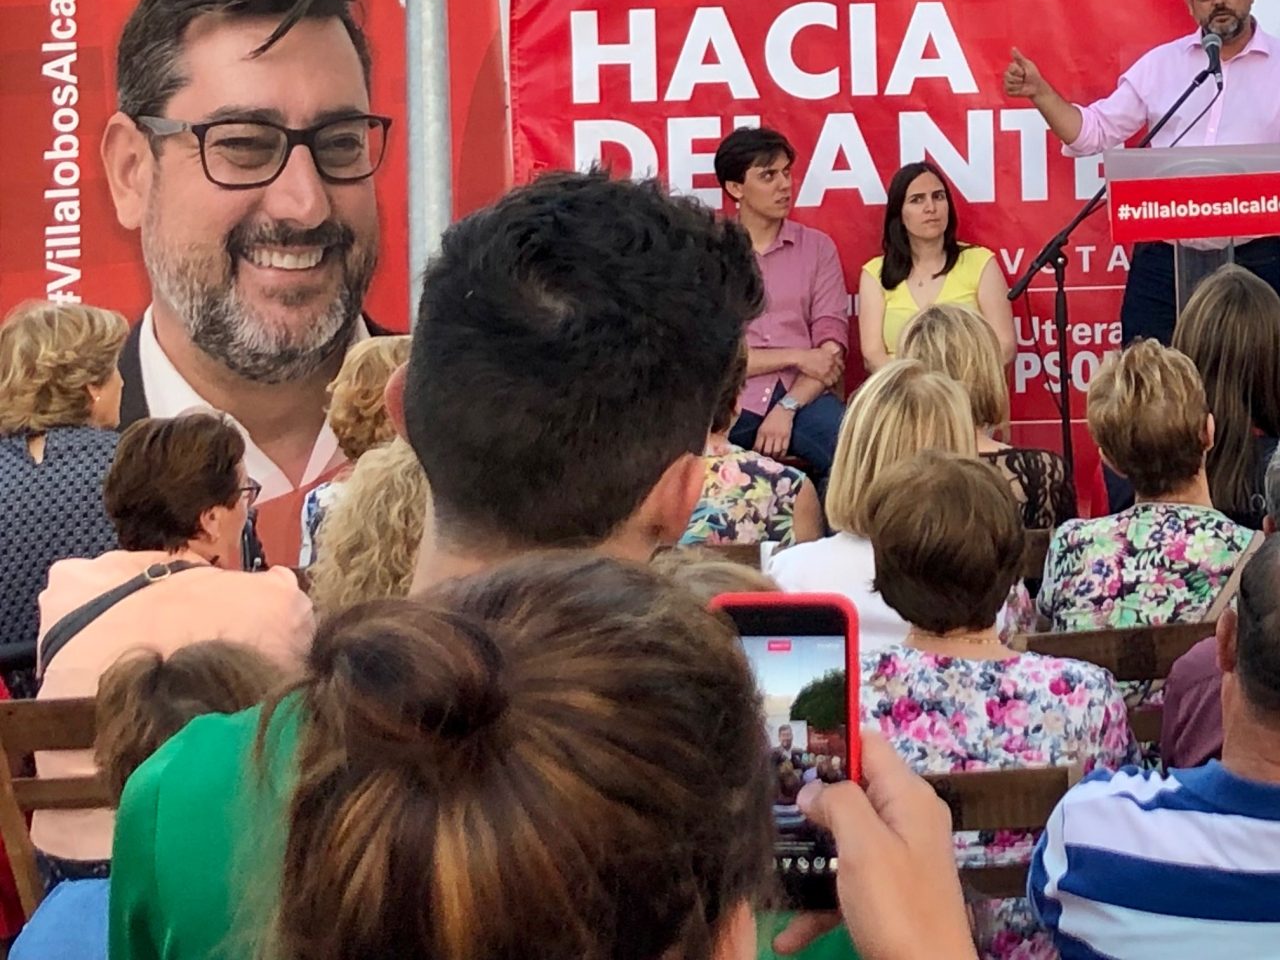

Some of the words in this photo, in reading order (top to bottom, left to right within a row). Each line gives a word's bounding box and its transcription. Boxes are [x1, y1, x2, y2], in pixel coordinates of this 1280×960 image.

[570, 1, 980, 104] HACIA
[573, 108, 1108, 212] DEANT
[1000, 244, 1131, 275] VTA
[1014, 316, 1122, 346] Utera
